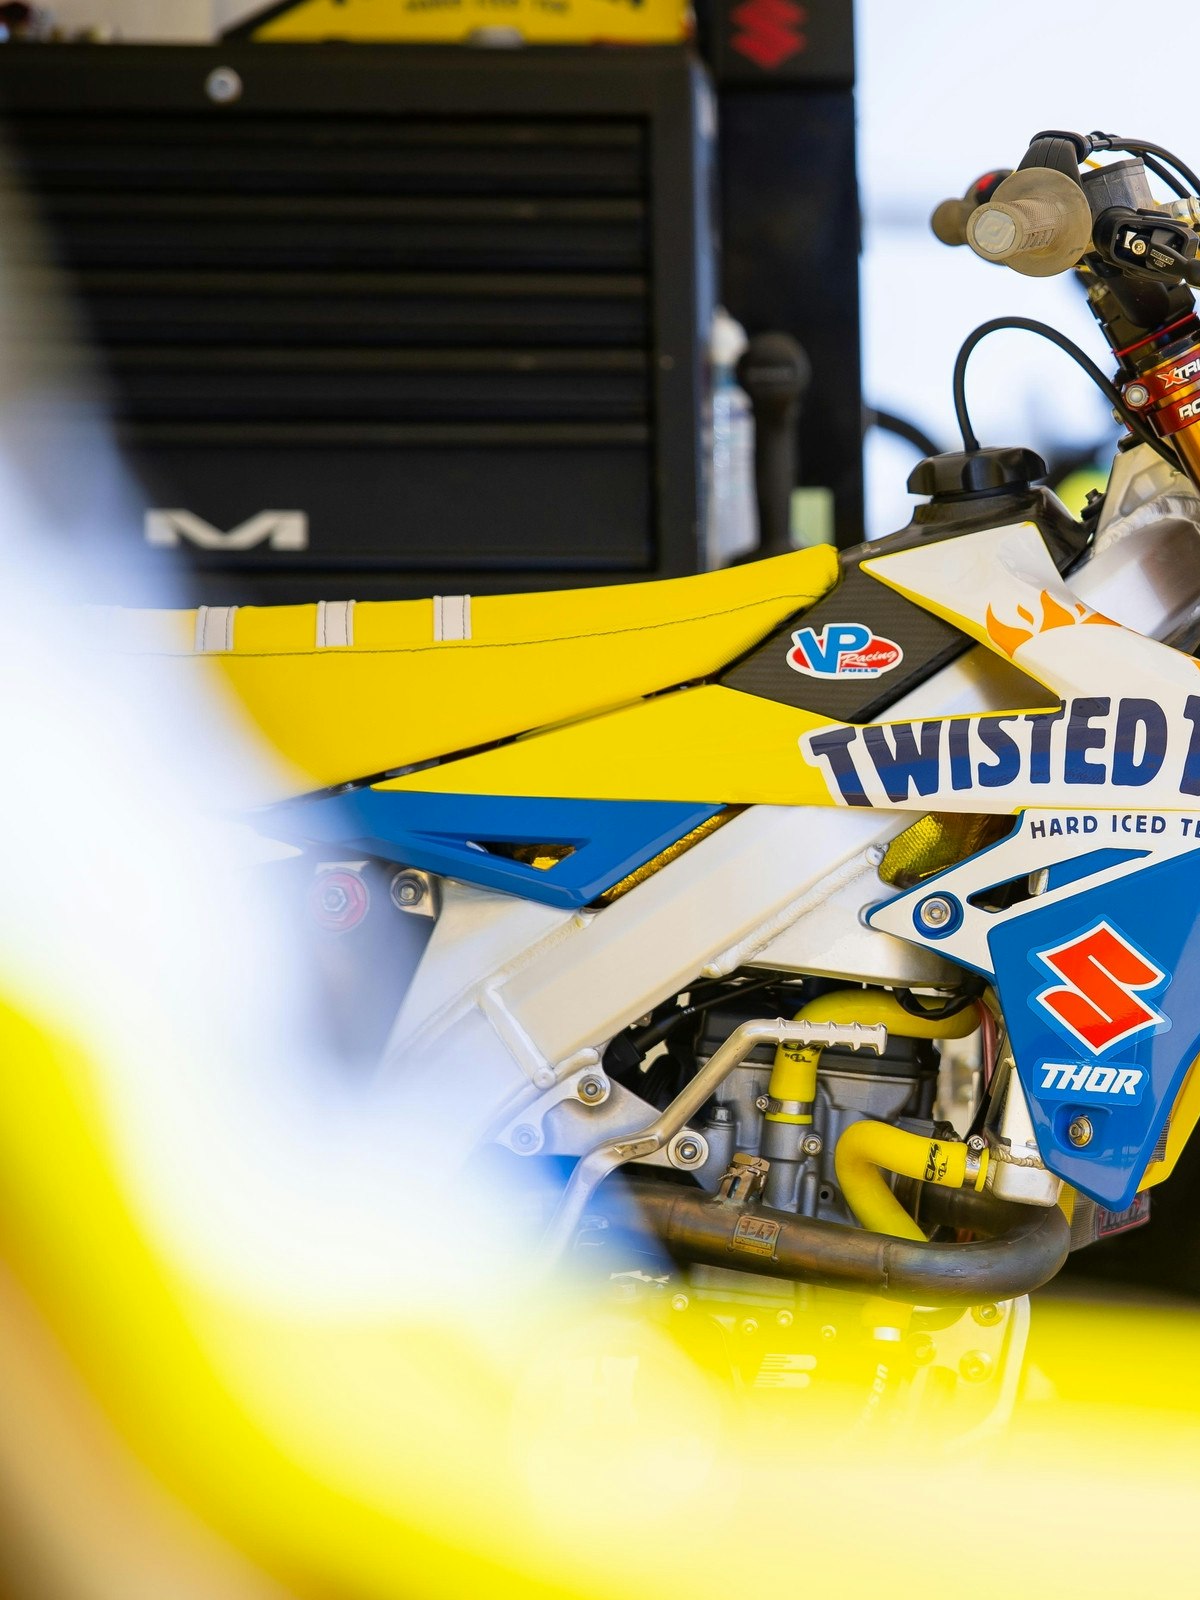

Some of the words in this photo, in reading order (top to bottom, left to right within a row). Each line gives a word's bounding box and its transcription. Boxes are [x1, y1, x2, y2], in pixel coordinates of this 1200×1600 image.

[797, 626, 870, 674] VP
[840, 650, 898, 667] Racing
[809, 696, 1168, 806] TWISTED
[1030, 815, 1099, 839] HARD
[1112, 814, 1167, 834] ICED
[1040, 1062, 1143, 1095] THOR
